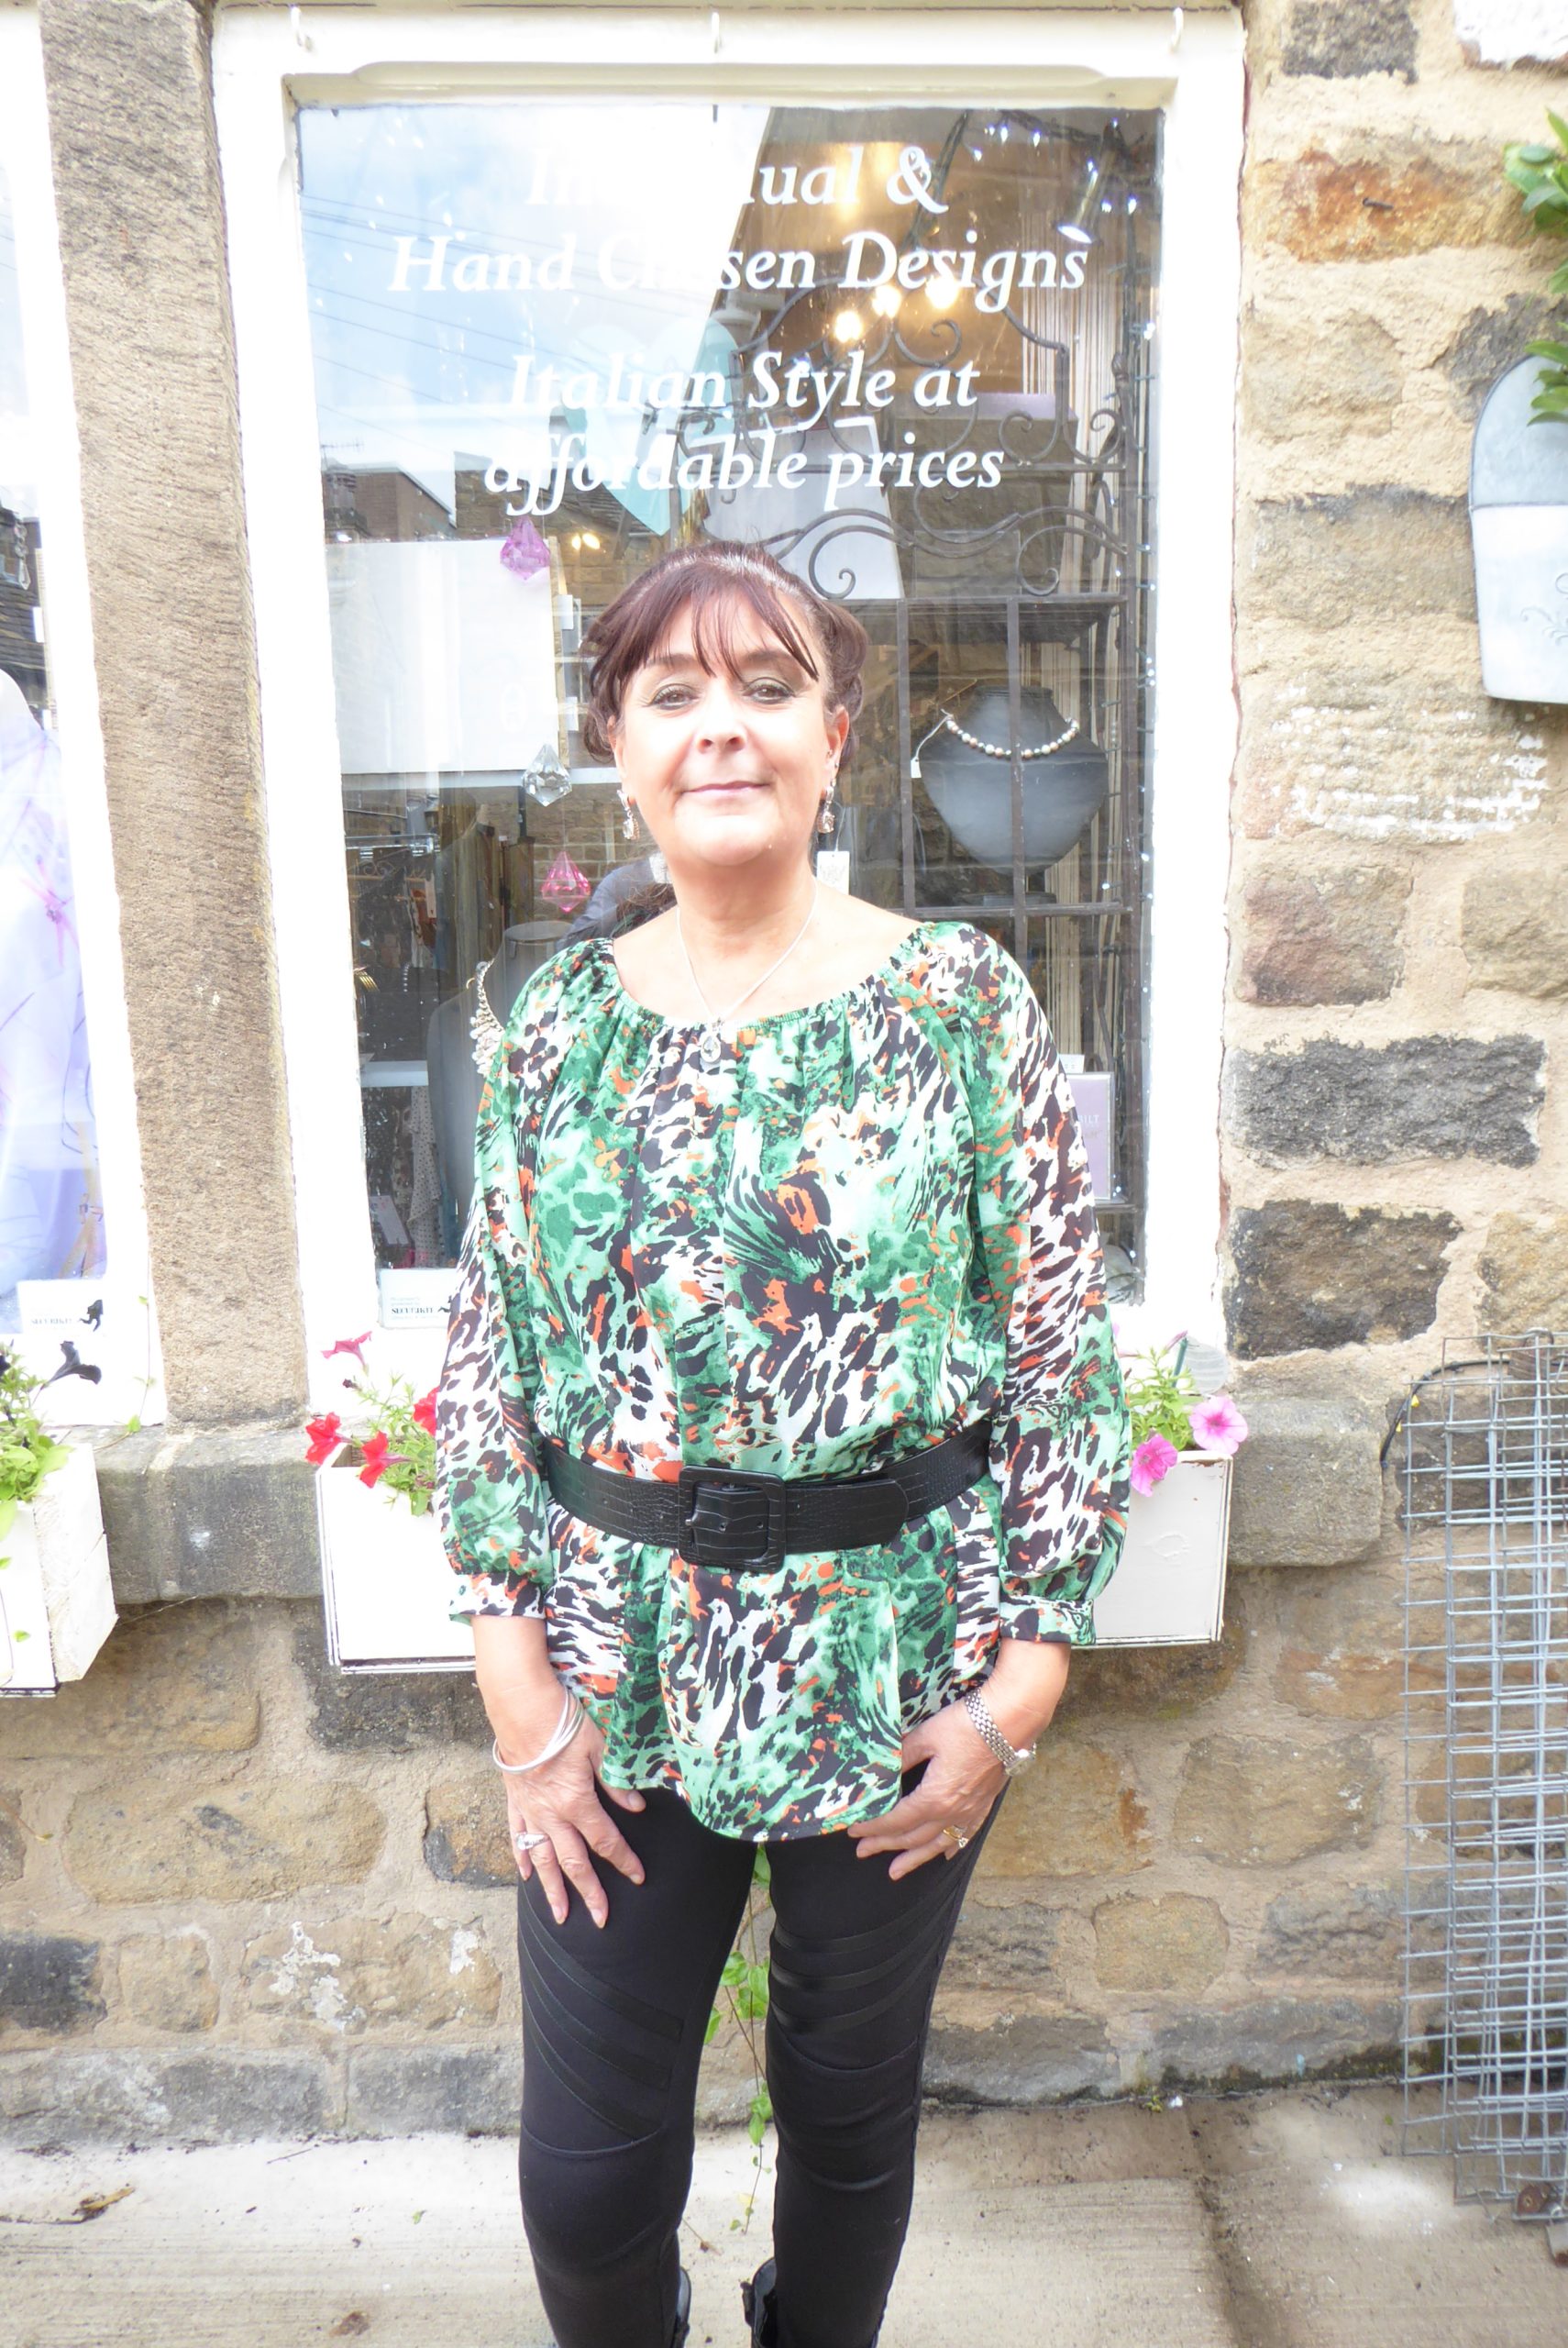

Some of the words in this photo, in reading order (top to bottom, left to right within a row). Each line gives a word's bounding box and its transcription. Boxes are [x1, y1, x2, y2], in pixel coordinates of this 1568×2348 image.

[525, 145, 865, 205] Inual
[886, 145, 949, 214] &
[386, 232, 578, 292] Hand
[597, 228, 816, 292] Csen
[836, 229, 1088, 313] Designs
[510, 351, 727, 410] Italian
[747, 349, 896, 431] Style
[913, 360, 981, 407] at
[483, 432, 808, 515] affordable
[823, 431, 1005, 513] prices
